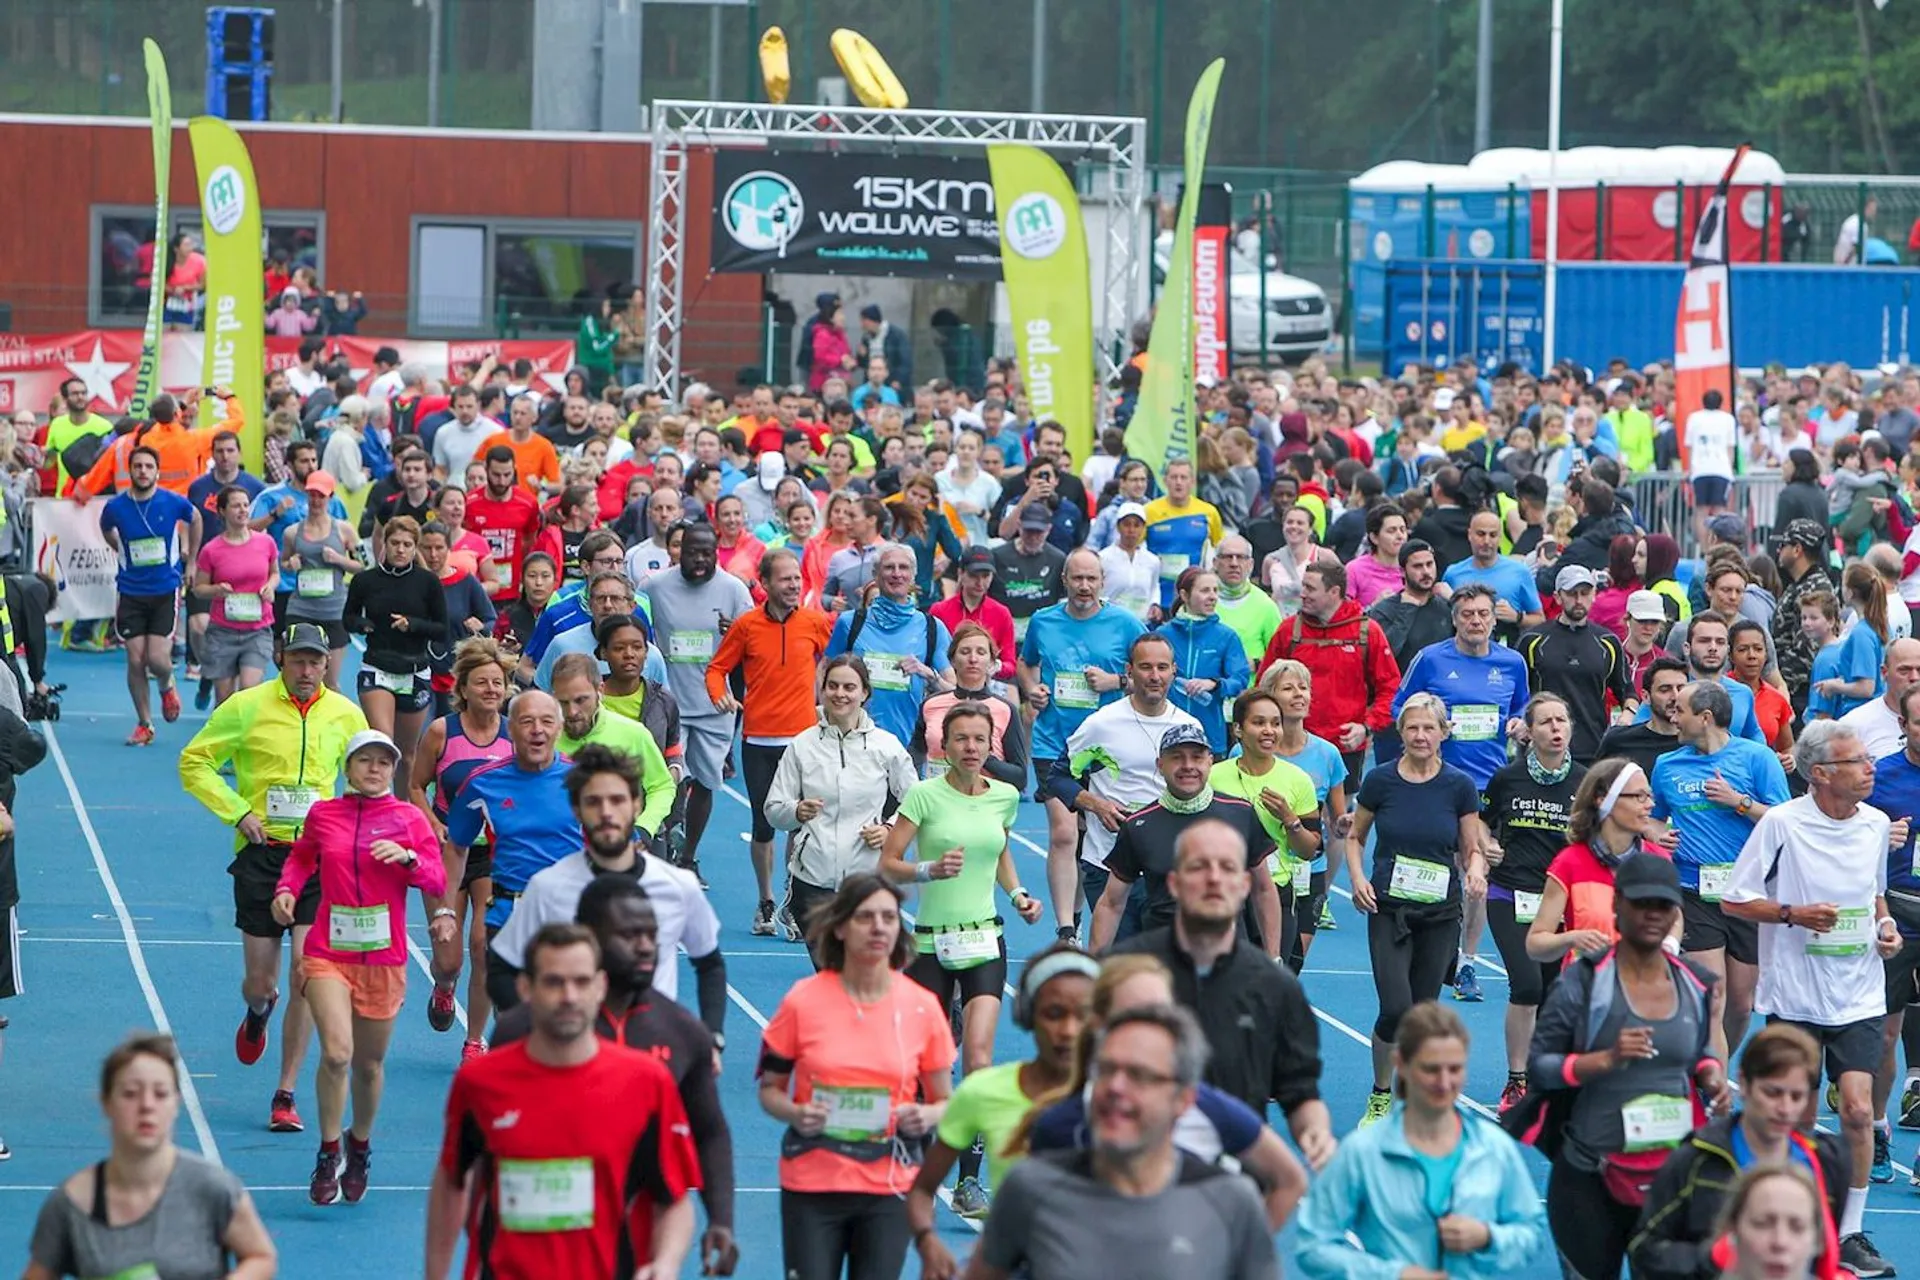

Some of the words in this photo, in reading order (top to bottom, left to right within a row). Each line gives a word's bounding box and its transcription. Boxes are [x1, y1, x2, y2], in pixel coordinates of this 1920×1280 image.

[34, 346, 76, 365] STAR
[1511, 797, 1537, 811] C'est
[1538, 798, 1563, 813] beau
[352, 916, 377, 929] 1415
